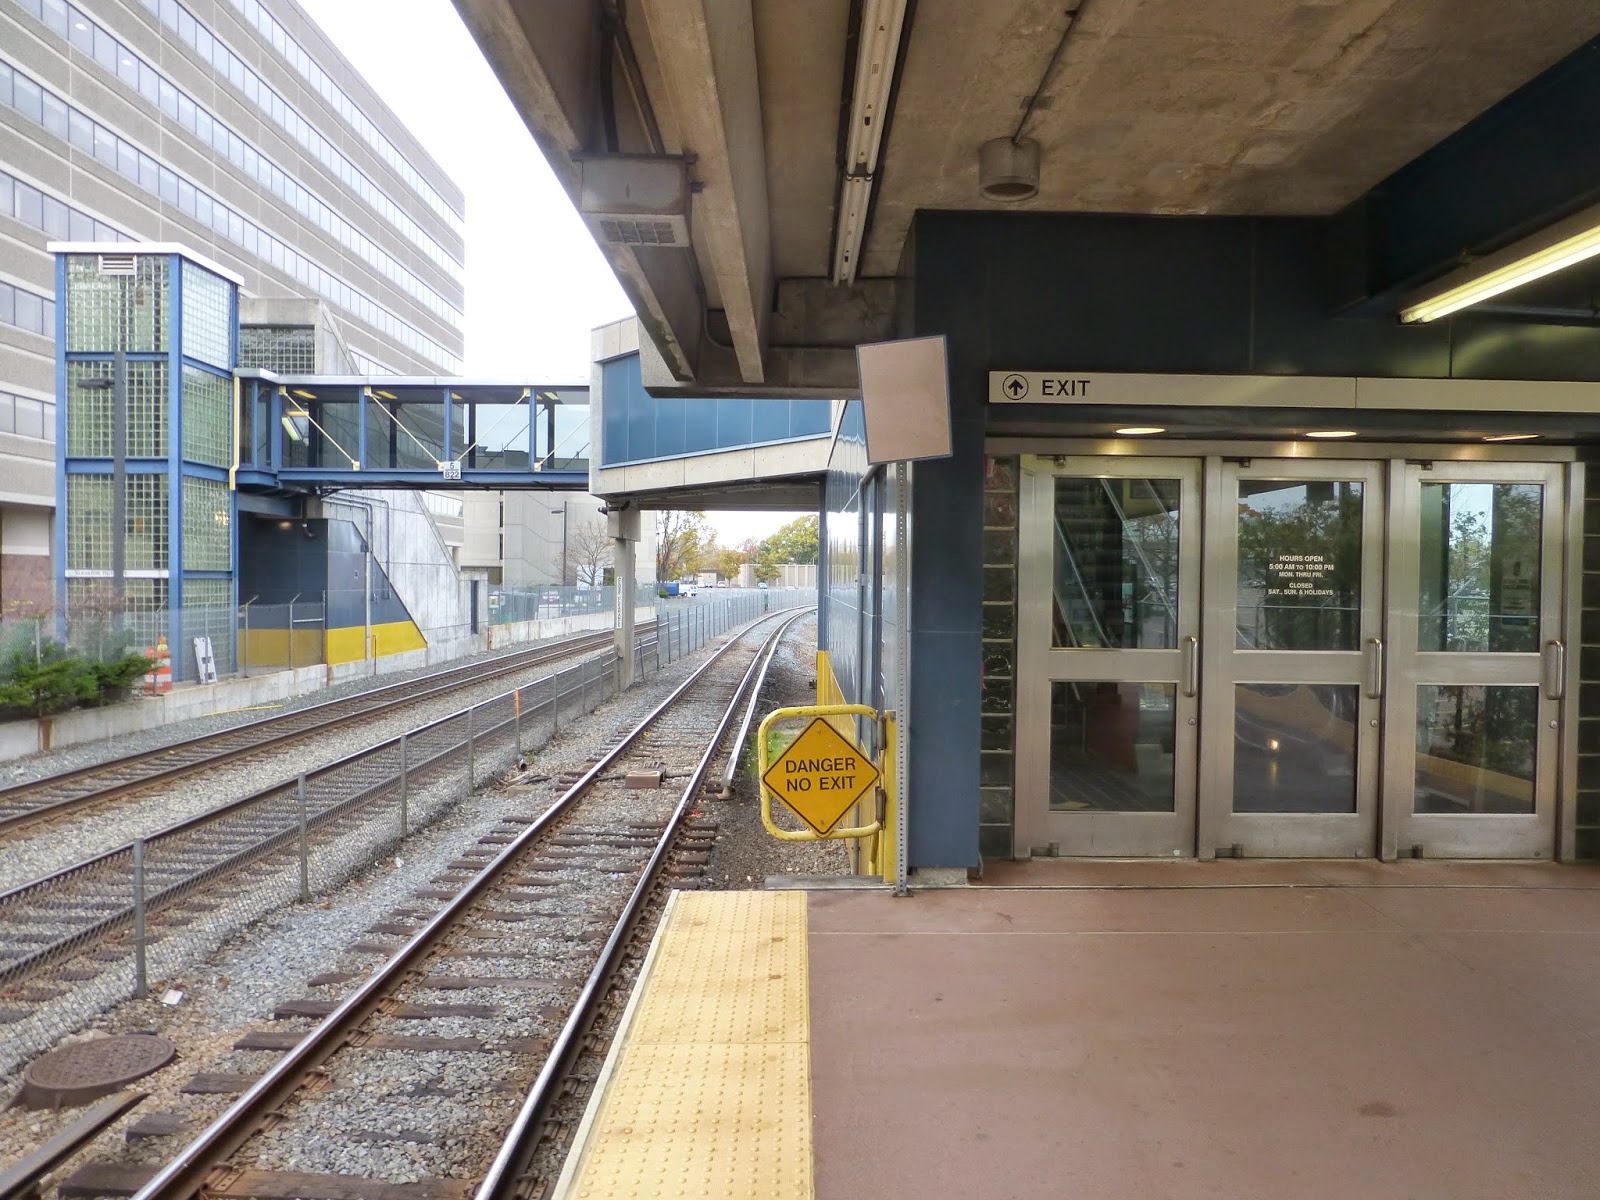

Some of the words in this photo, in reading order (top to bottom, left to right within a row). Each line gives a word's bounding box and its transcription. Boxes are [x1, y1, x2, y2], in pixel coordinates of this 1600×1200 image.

[1042, 380, 1090, 396] EXIT
[785, 758, 856, 773] DANGER
[786, 778, 811, 792] NO
[820, 776, 856, 790] EXIT
